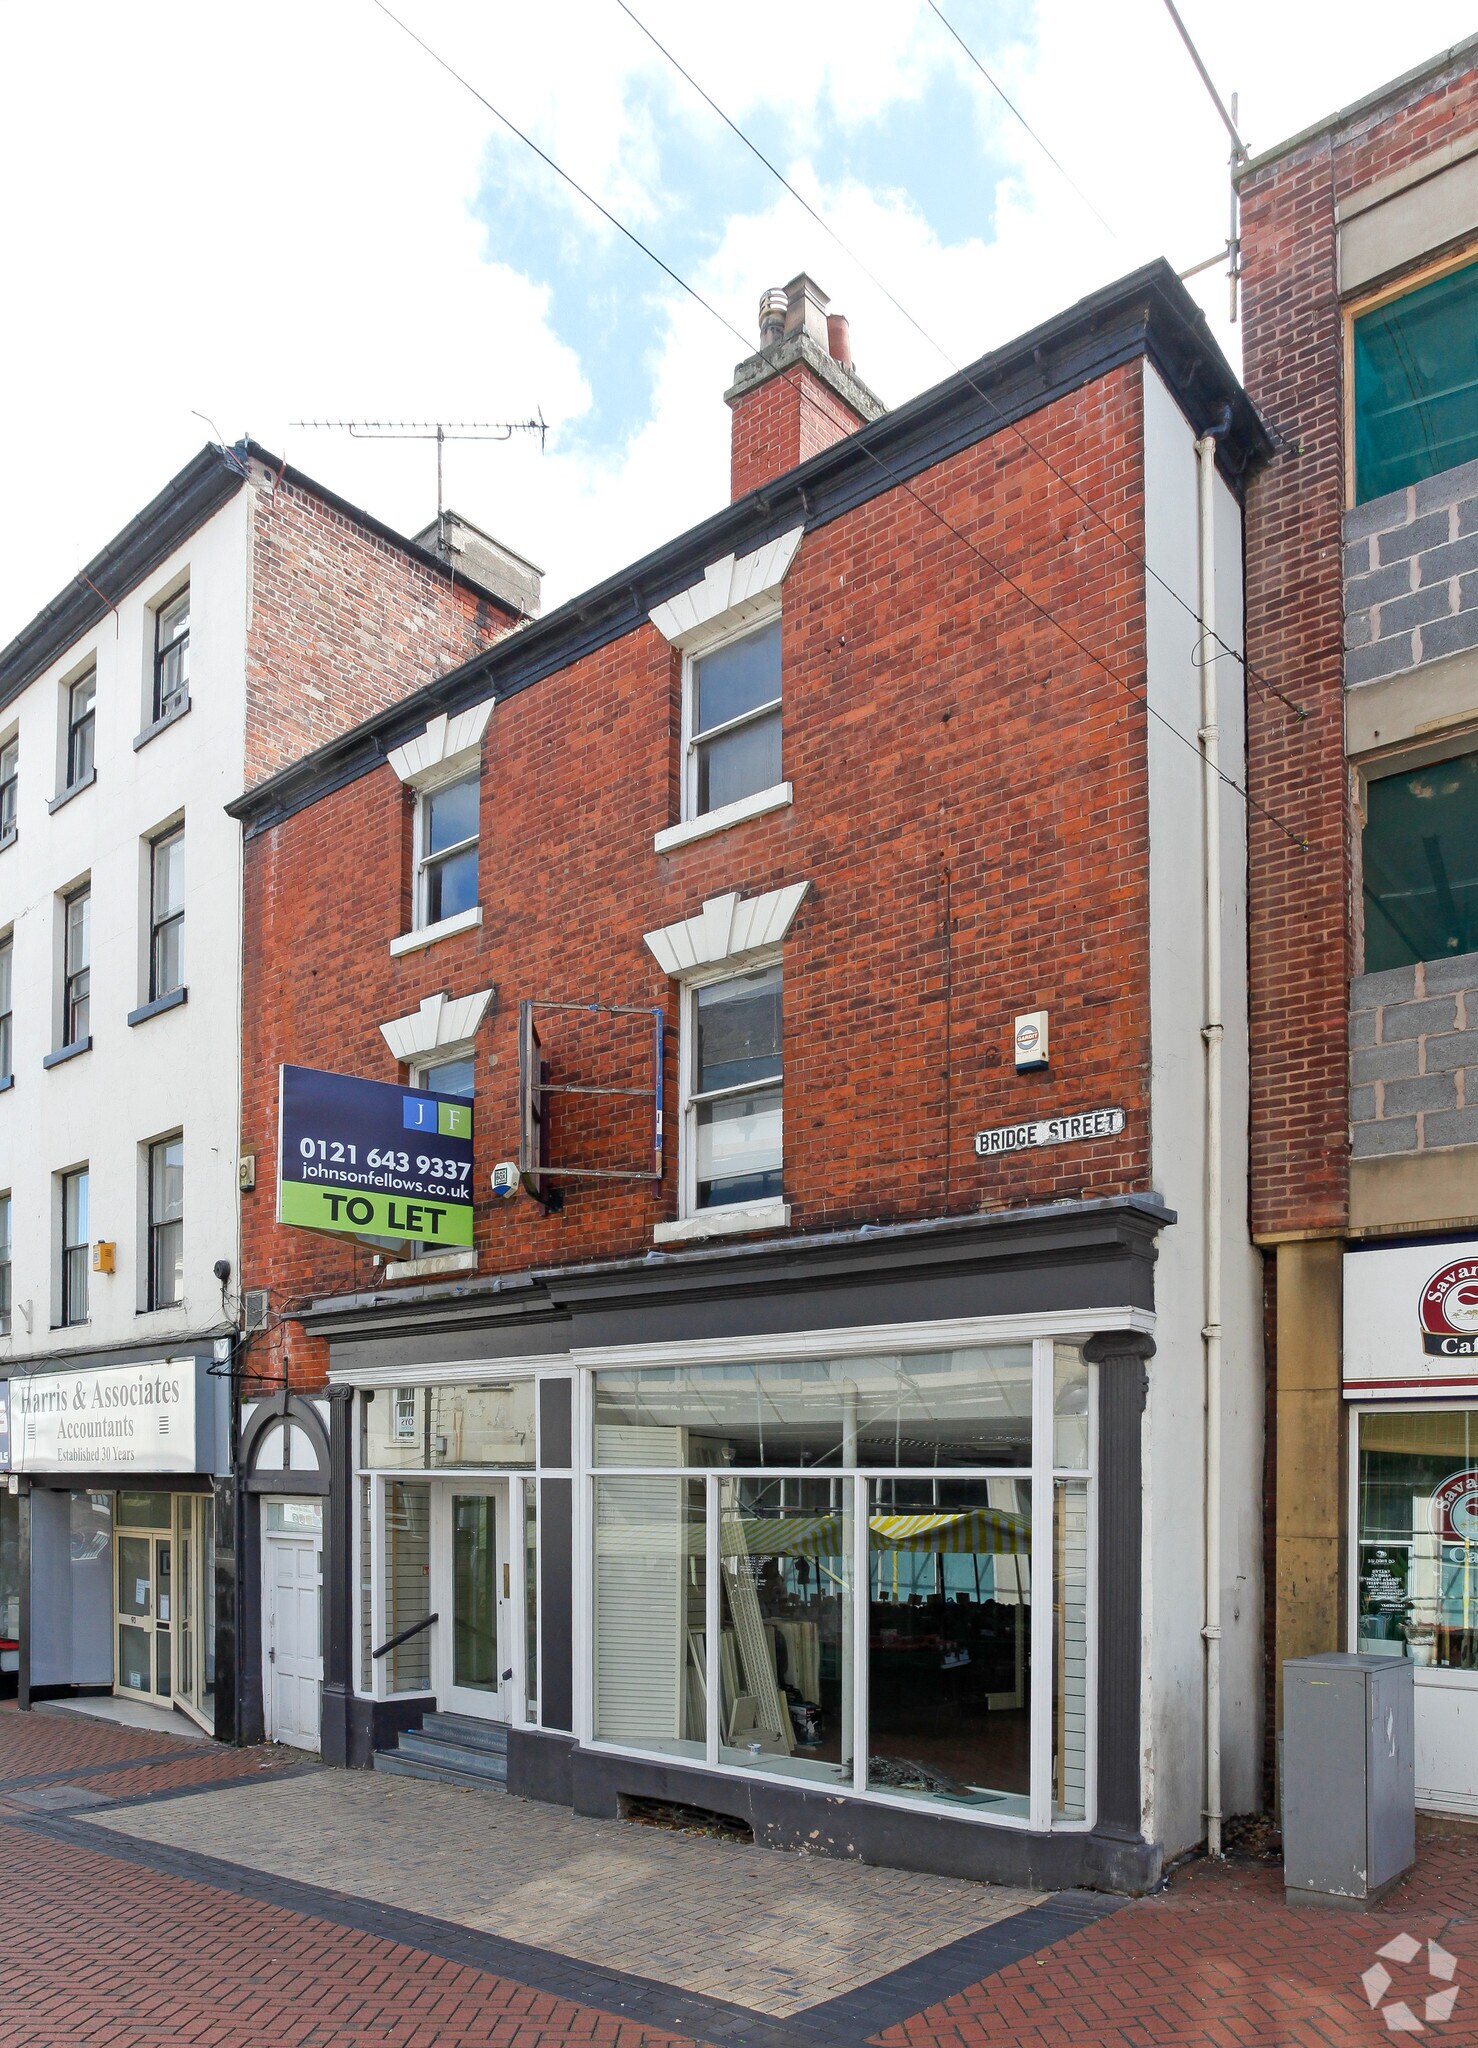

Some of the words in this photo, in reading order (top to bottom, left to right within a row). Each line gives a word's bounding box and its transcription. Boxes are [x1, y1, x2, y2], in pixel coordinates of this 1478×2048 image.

[415, 1103, 424, 1125] J
[448, 1109, 461, 1130] F
[979, 1125, 1038, 1152] BRIDGE
[1048, 1111, 1117, 1139] STREET
[299, 1137, 356, 1165] 0121
[366, 1148, 410, 1172] 643
[415, 1155, 471, 1181] 9337
[302, 1162, 470, 1199] johnsonfellows.co.uk
[318, 1192, 375, 1225] TO
[388, 1201, 447, 1234] LET
[20, 1383, 67, 1414] Harris
[72, 1380, 87, 1411] &
[91, 1374, 179, 1409] Associates
[57, 1415, 134, 1440] Accountants
[57, 1447, 100, 1462] Established
[101, 1447, 111, 1460] 30
[113, 1446, 135, 1461] Years
